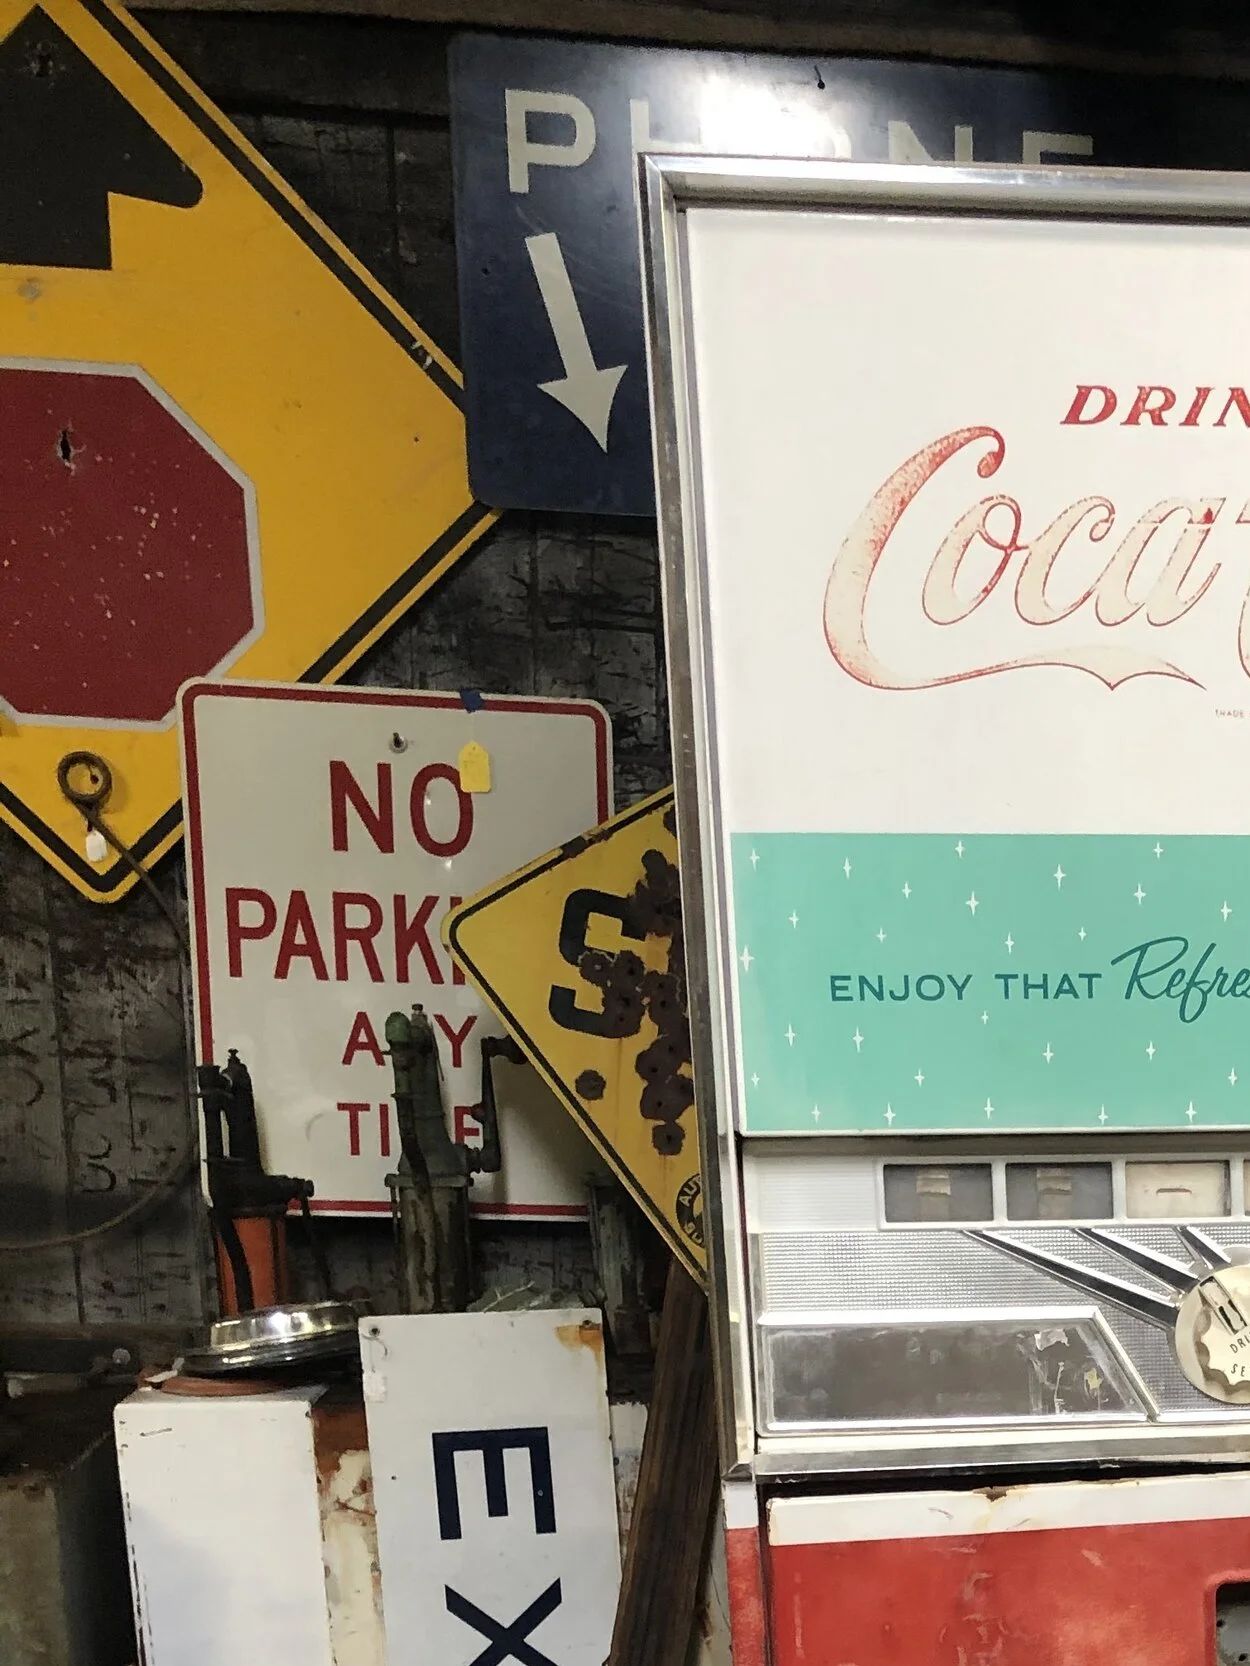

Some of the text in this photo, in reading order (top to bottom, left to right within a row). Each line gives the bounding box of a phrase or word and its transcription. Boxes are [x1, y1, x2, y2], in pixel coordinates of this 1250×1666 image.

[329, 760, 474, 857] NO
[225, 887, 466, 986] PARK
[829, 973, 972, 1003] ENJOY
[994, 971, 1102, 1000] THAT
[341, 1011, 478, 1068] AY
[336, 1102, 480, 1157] TIE
